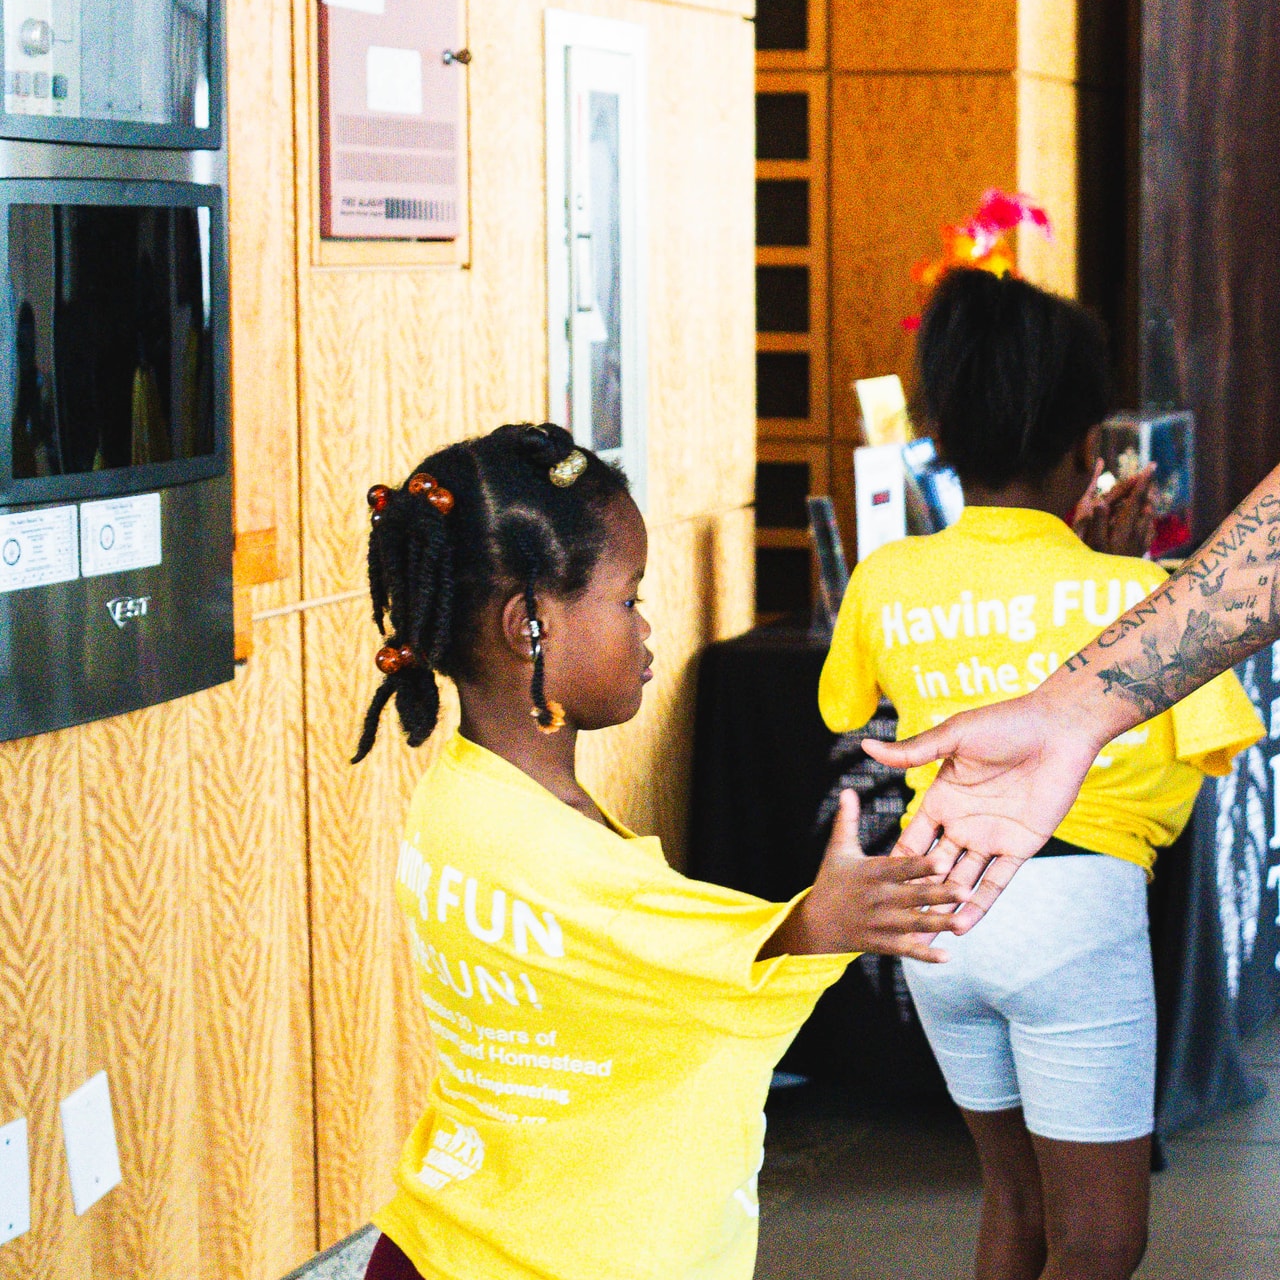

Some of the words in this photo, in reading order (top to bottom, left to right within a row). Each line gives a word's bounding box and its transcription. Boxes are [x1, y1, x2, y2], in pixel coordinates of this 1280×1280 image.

[880, 590, 1037, 649] Having
[911, 664, 950, 699] in
[955, 656, 1020, 696] the
[437, 865, 566, 958] FUN
[475, 1024, 530, 1045] years
[535, 1029, 558, 1047] of
[488, 1046, 613, 1077] Homestead
[476, 1073, 571, 1105] Empowering
